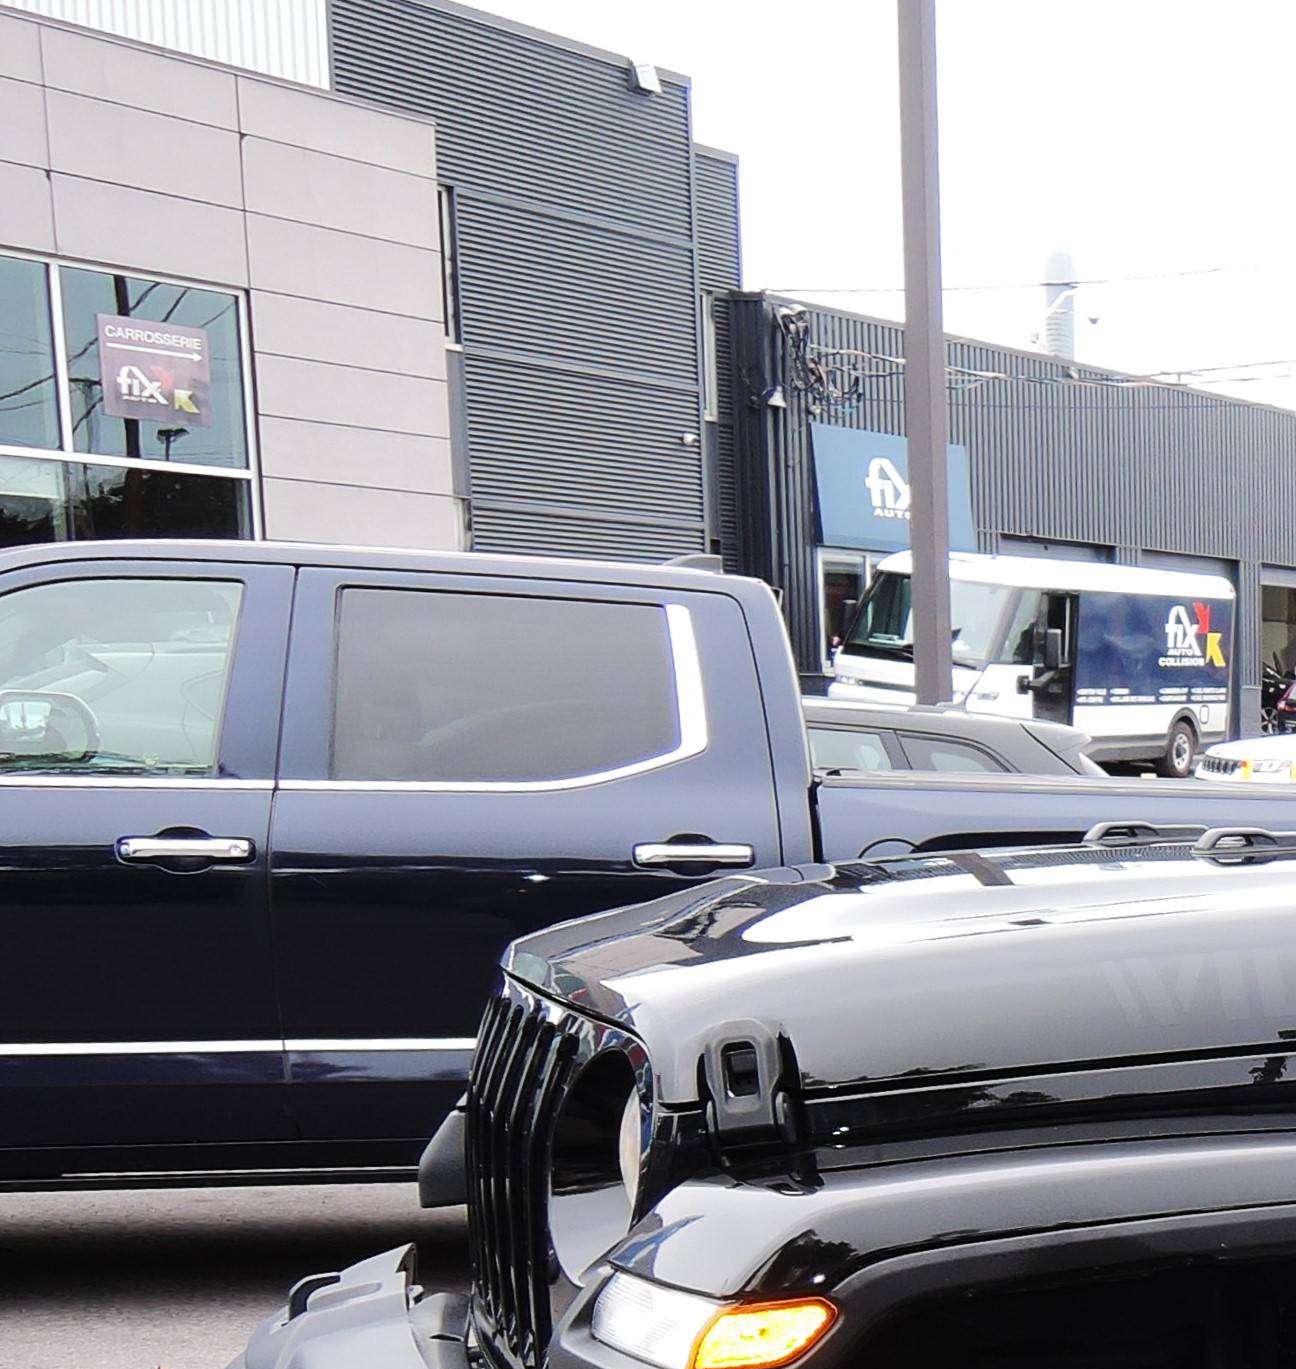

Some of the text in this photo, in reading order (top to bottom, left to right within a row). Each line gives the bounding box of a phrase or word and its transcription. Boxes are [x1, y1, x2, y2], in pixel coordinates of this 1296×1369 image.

[104, 325, 202, 350] CARROSSERIE
[116, 366, 169, 404] fix
[1165, 605, 1202, 656] fix
